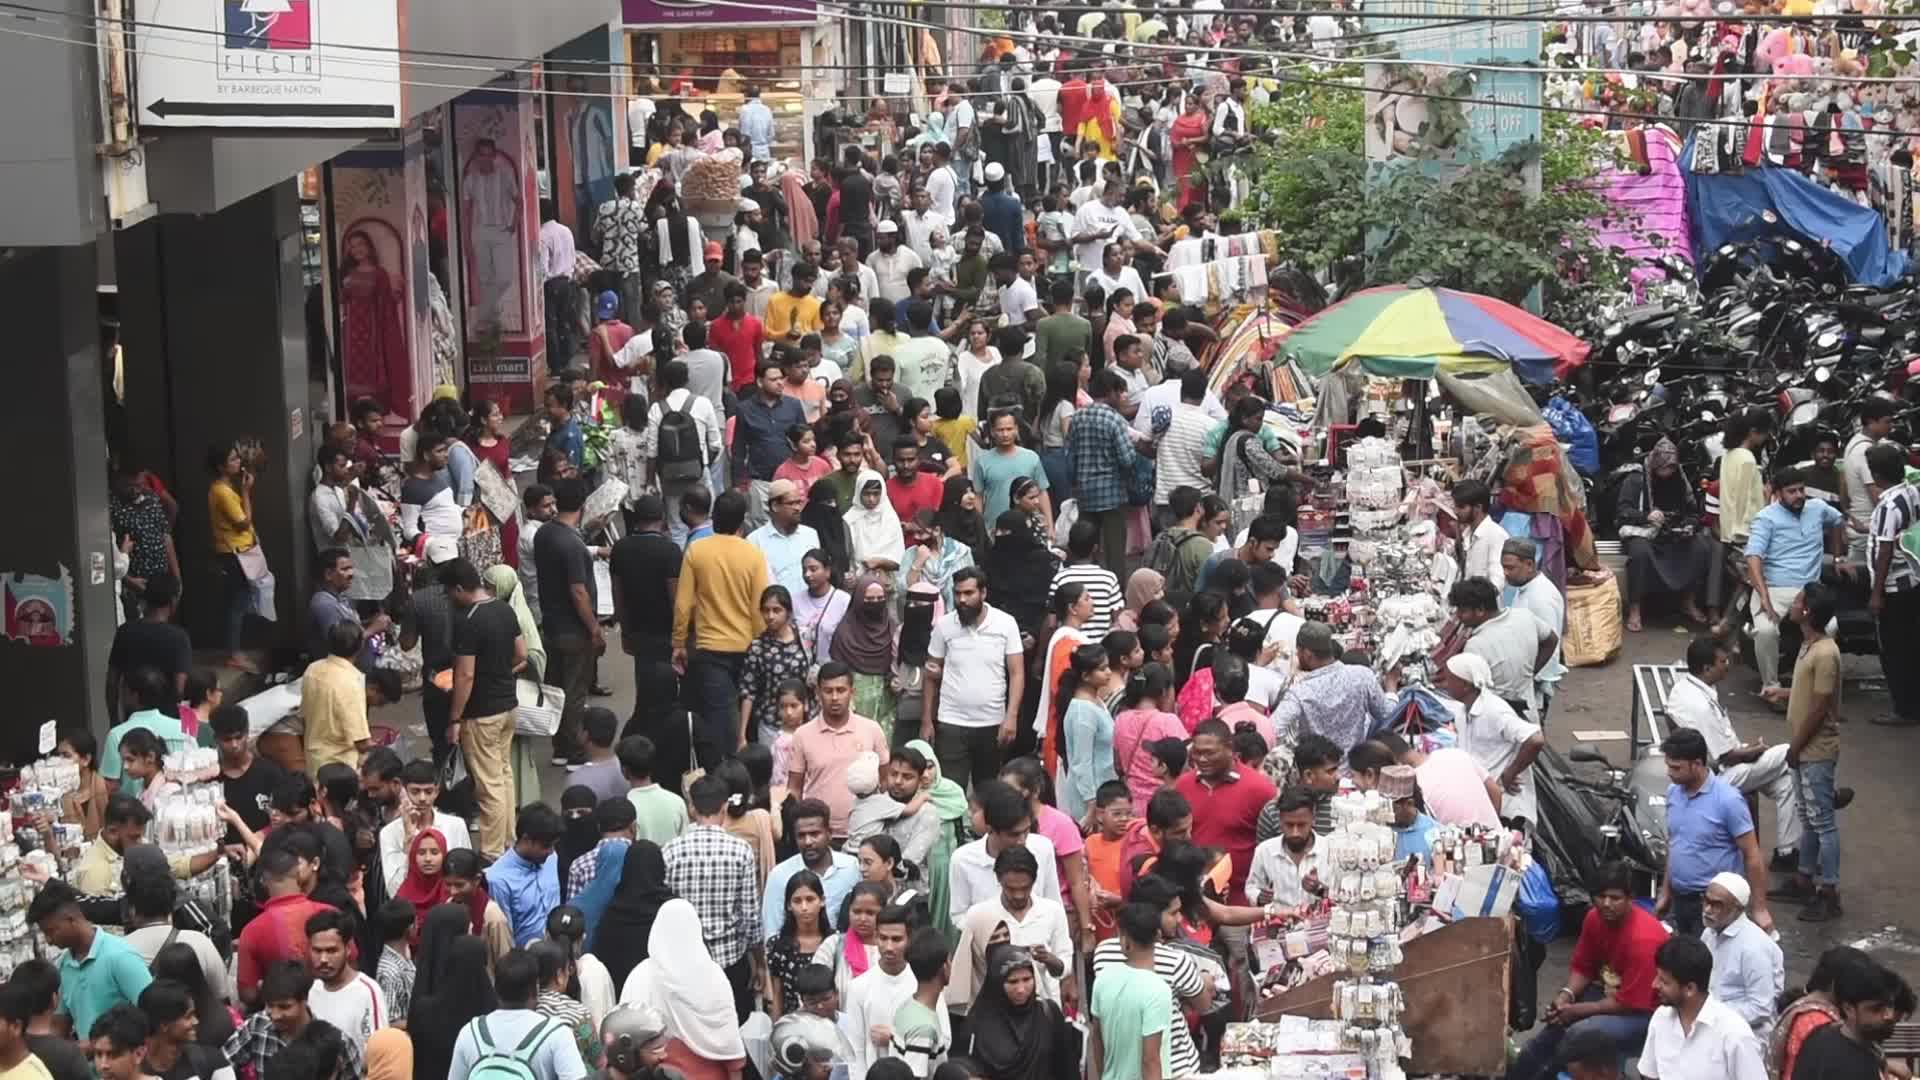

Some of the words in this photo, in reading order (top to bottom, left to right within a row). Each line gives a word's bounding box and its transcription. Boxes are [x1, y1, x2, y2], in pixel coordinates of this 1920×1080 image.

[224, 55, 312, 73] FIESTA
[231, 84, 281, 95] BARBEQUE
[284, 85, 321, 95] NATION
[1501, 113, 1523, 132] OFF
